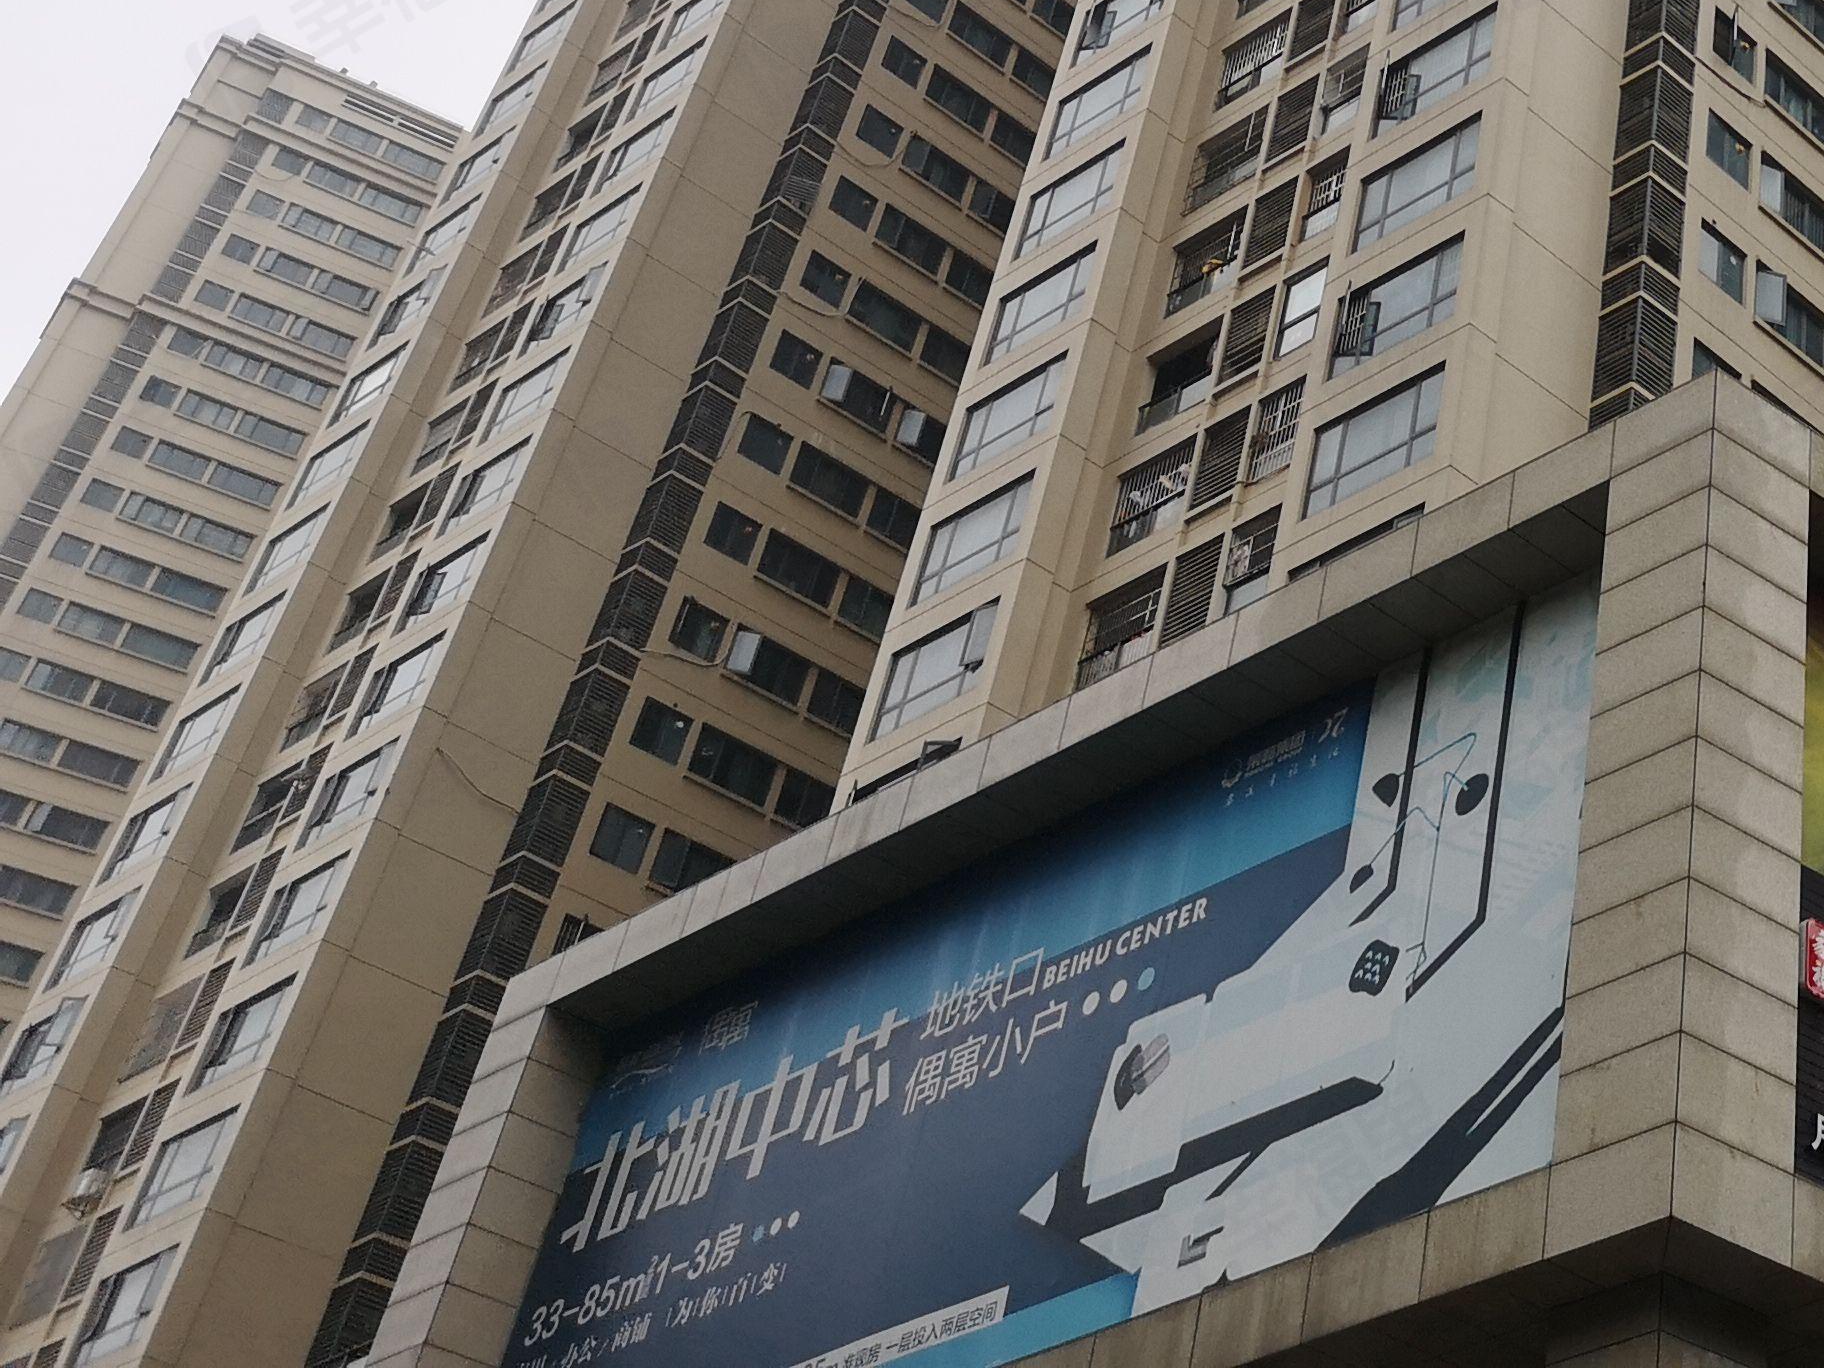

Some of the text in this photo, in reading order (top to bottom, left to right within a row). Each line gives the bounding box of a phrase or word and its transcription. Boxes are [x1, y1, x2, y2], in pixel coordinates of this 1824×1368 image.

[920, 896, 1208, 1041] 地铁口 BEIHU CENTER
